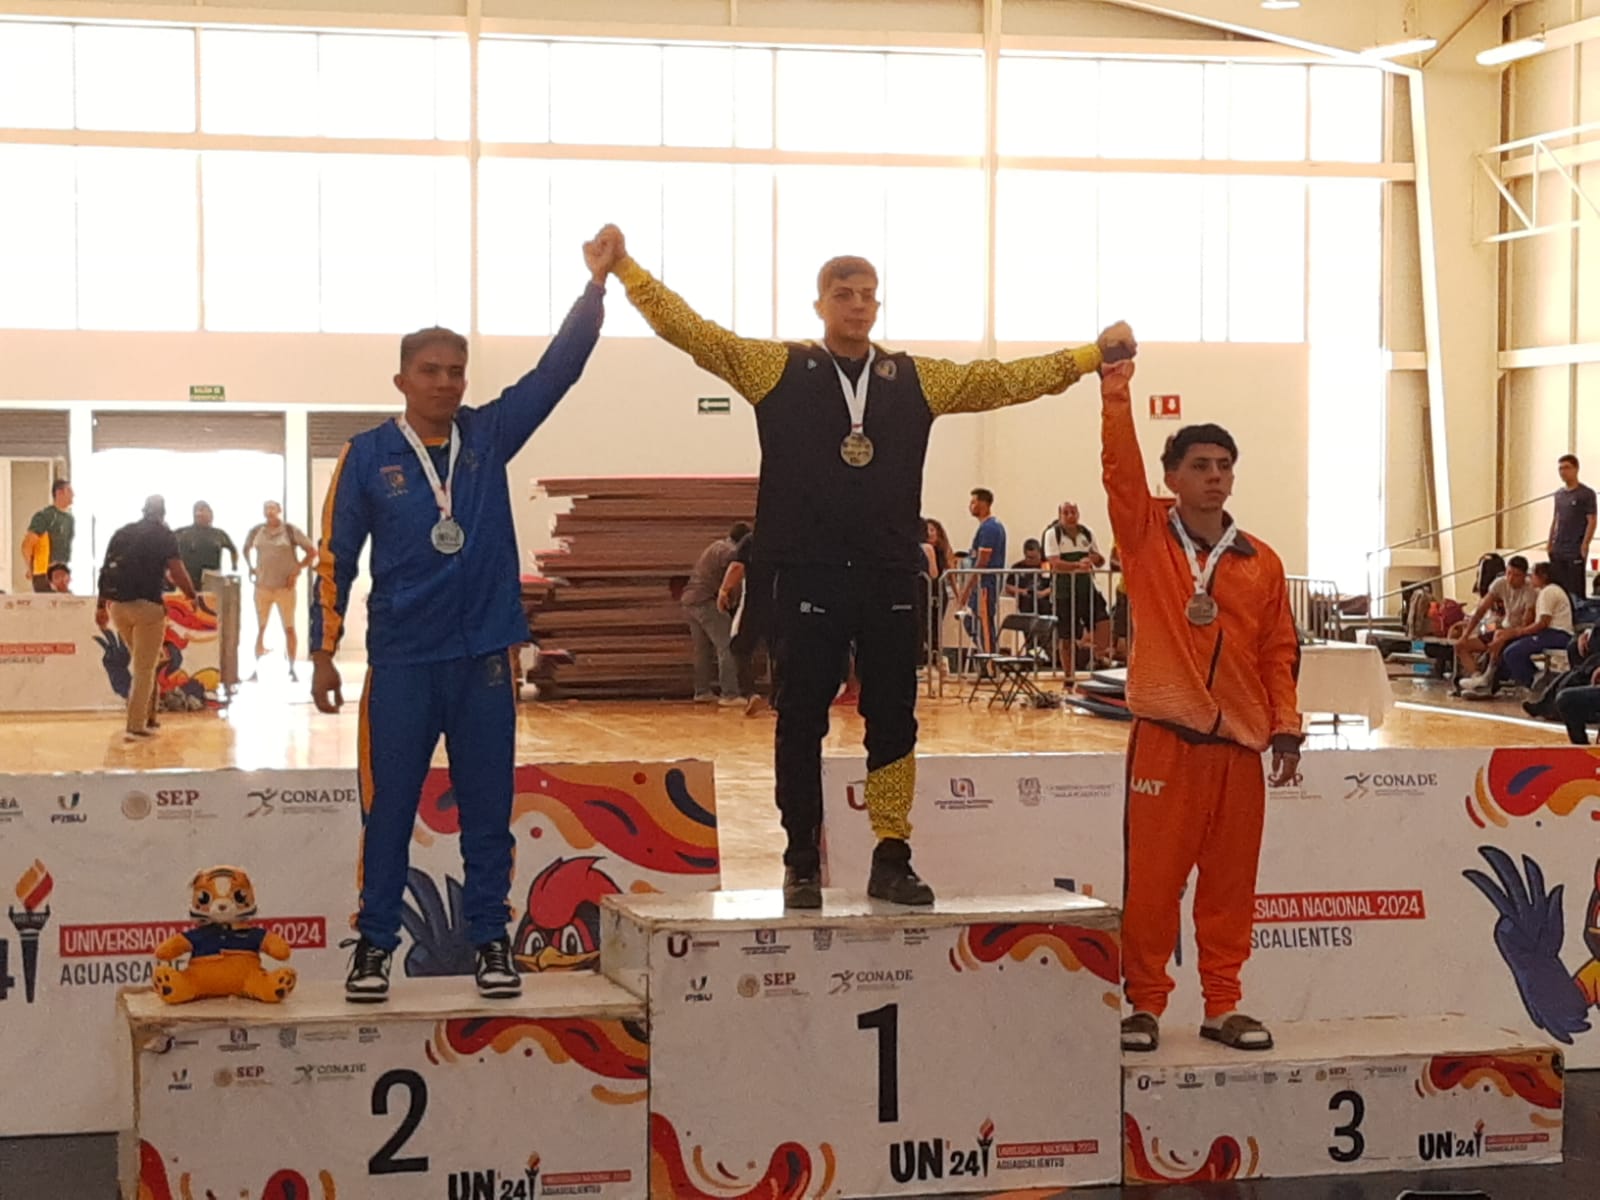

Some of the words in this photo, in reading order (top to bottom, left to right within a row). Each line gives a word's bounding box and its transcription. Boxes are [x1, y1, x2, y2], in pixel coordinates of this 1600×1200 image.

[1130, 776, 1167, 797] UAT
[1373, 773, 1438, 787] CONADE
[156, 790, 199, 806] SEP
[281, 789, 357, 803] CONADE
[1254, 898, 1299, 919] SIADA
[1302, 896, 1376, 917] NACIONAL
[1377, 895, 1421, 915] 2024
[64, 927, 178, 953] UNIVERSIADA
[1250, 926, 1352, 949] SCALIENTES
[763, 972, 796, 986] SEP
[856, 969, 914, 983] CONADE
[236, 1065, 264, 1078] SEP
[857, 1003, 898, 1123] 1
[368, 1069, 428, 1175] 2
[1327, 1090, 1365, 1163] 3
